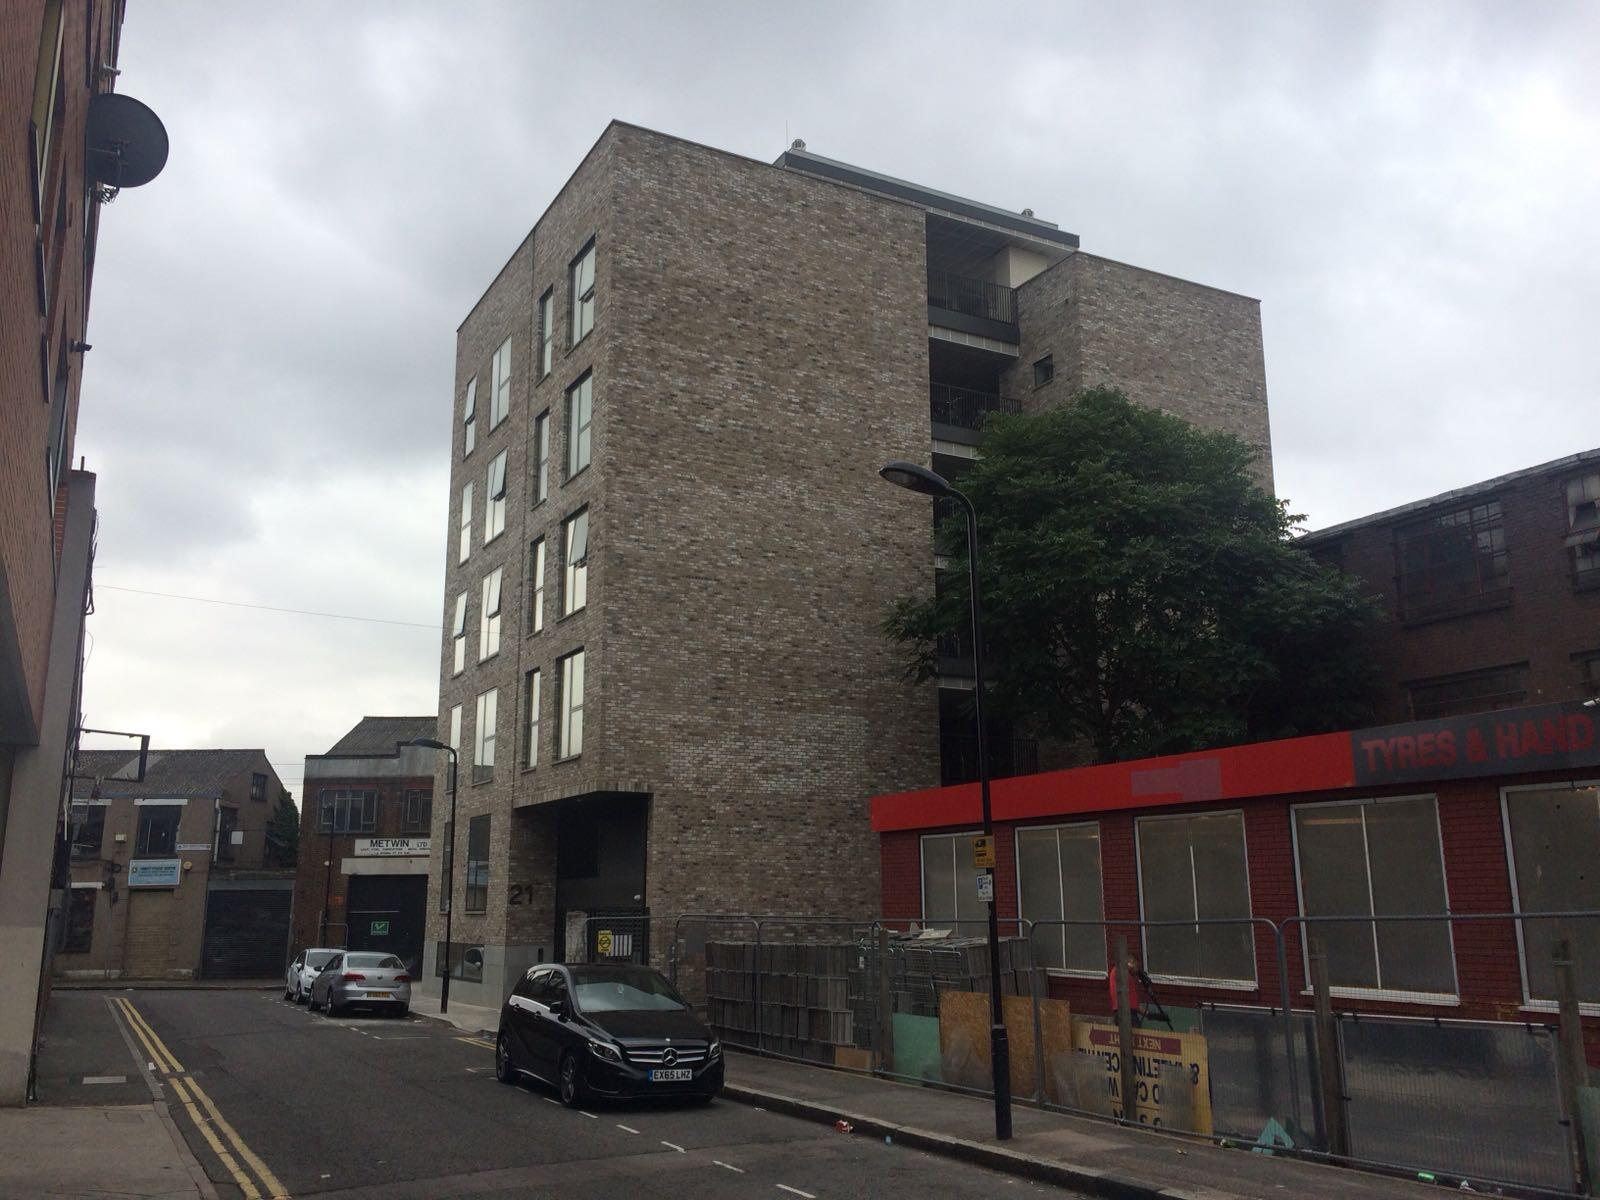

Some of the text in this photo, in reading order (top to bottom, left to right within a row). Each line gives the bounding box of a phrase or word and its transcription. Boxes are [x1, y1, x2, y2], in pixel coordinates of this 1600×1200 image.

[1360, 713, 1594, 773] TYRES & HAND
[370, 839, 410, 848] METWIN
[509, 884, 533, 906] 21
[1137, 1037, 1162, 1051] NEXT
